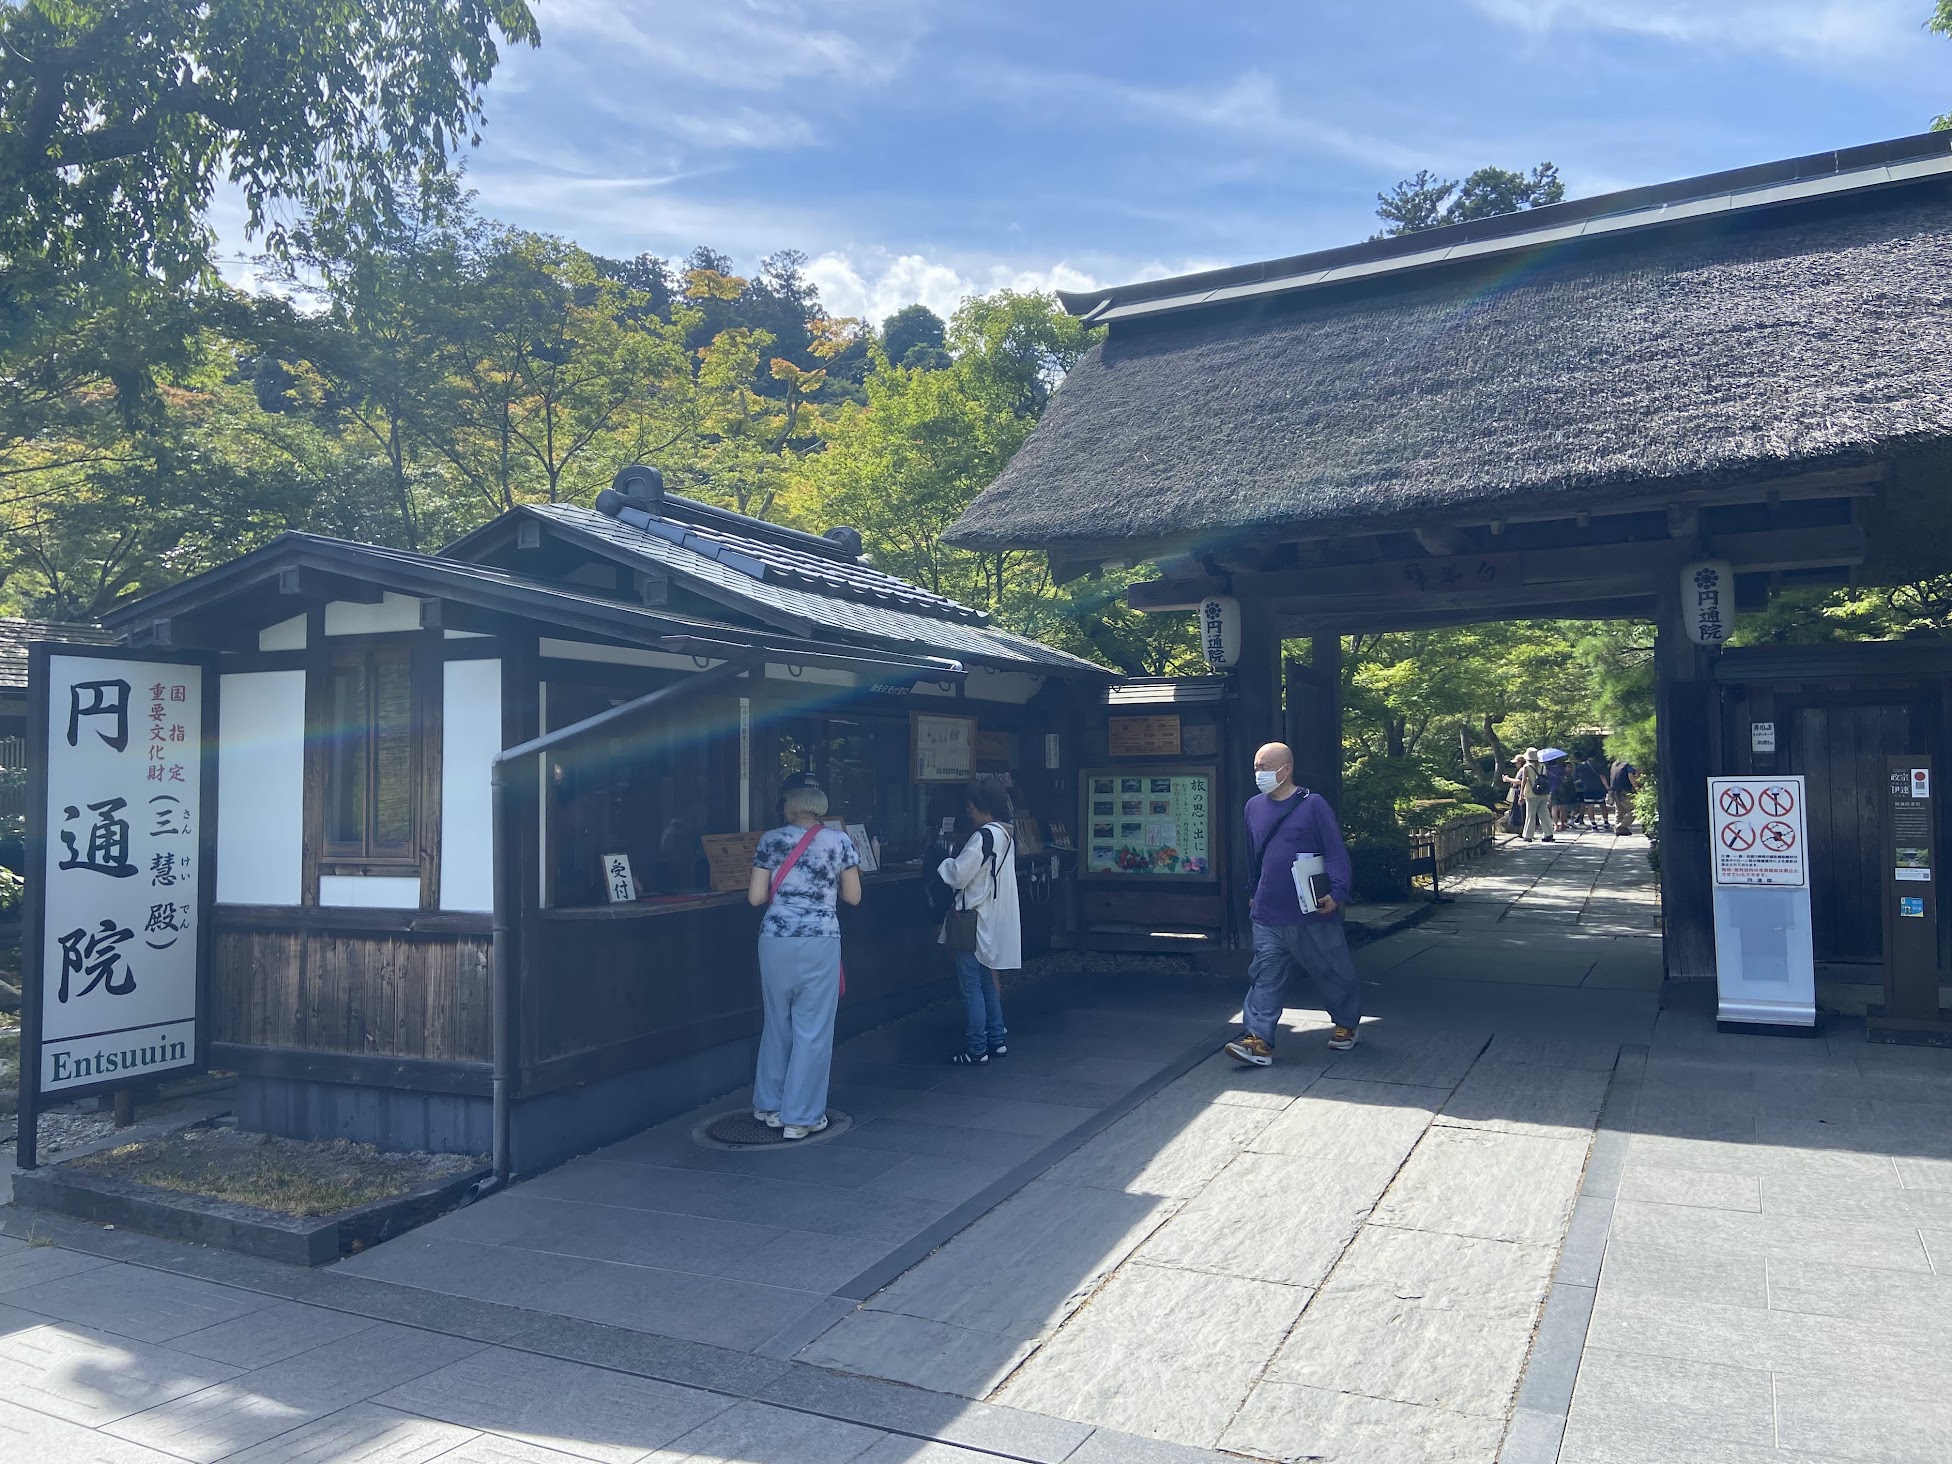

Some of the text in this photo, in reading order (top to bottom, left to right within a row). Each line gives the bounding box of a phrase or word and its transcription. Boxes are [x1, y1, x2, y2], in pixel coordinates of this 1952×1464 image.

[1698, 589, 1722, 640] 円通院
[1207, 619, 1227, 663] 円通院
[147, 682, 166, 783] 重要文化財
[168, 684, 186, 783] 国指定
[1890, 773, 1909, 781] 政宗
[1191, 779, 1206, 851] 旅の思い出に
[58, 678, 139, 1004] 円通院
[610, 859, 629, 899] 受付
[50, 1034, 187, 1083] Entsuuin
